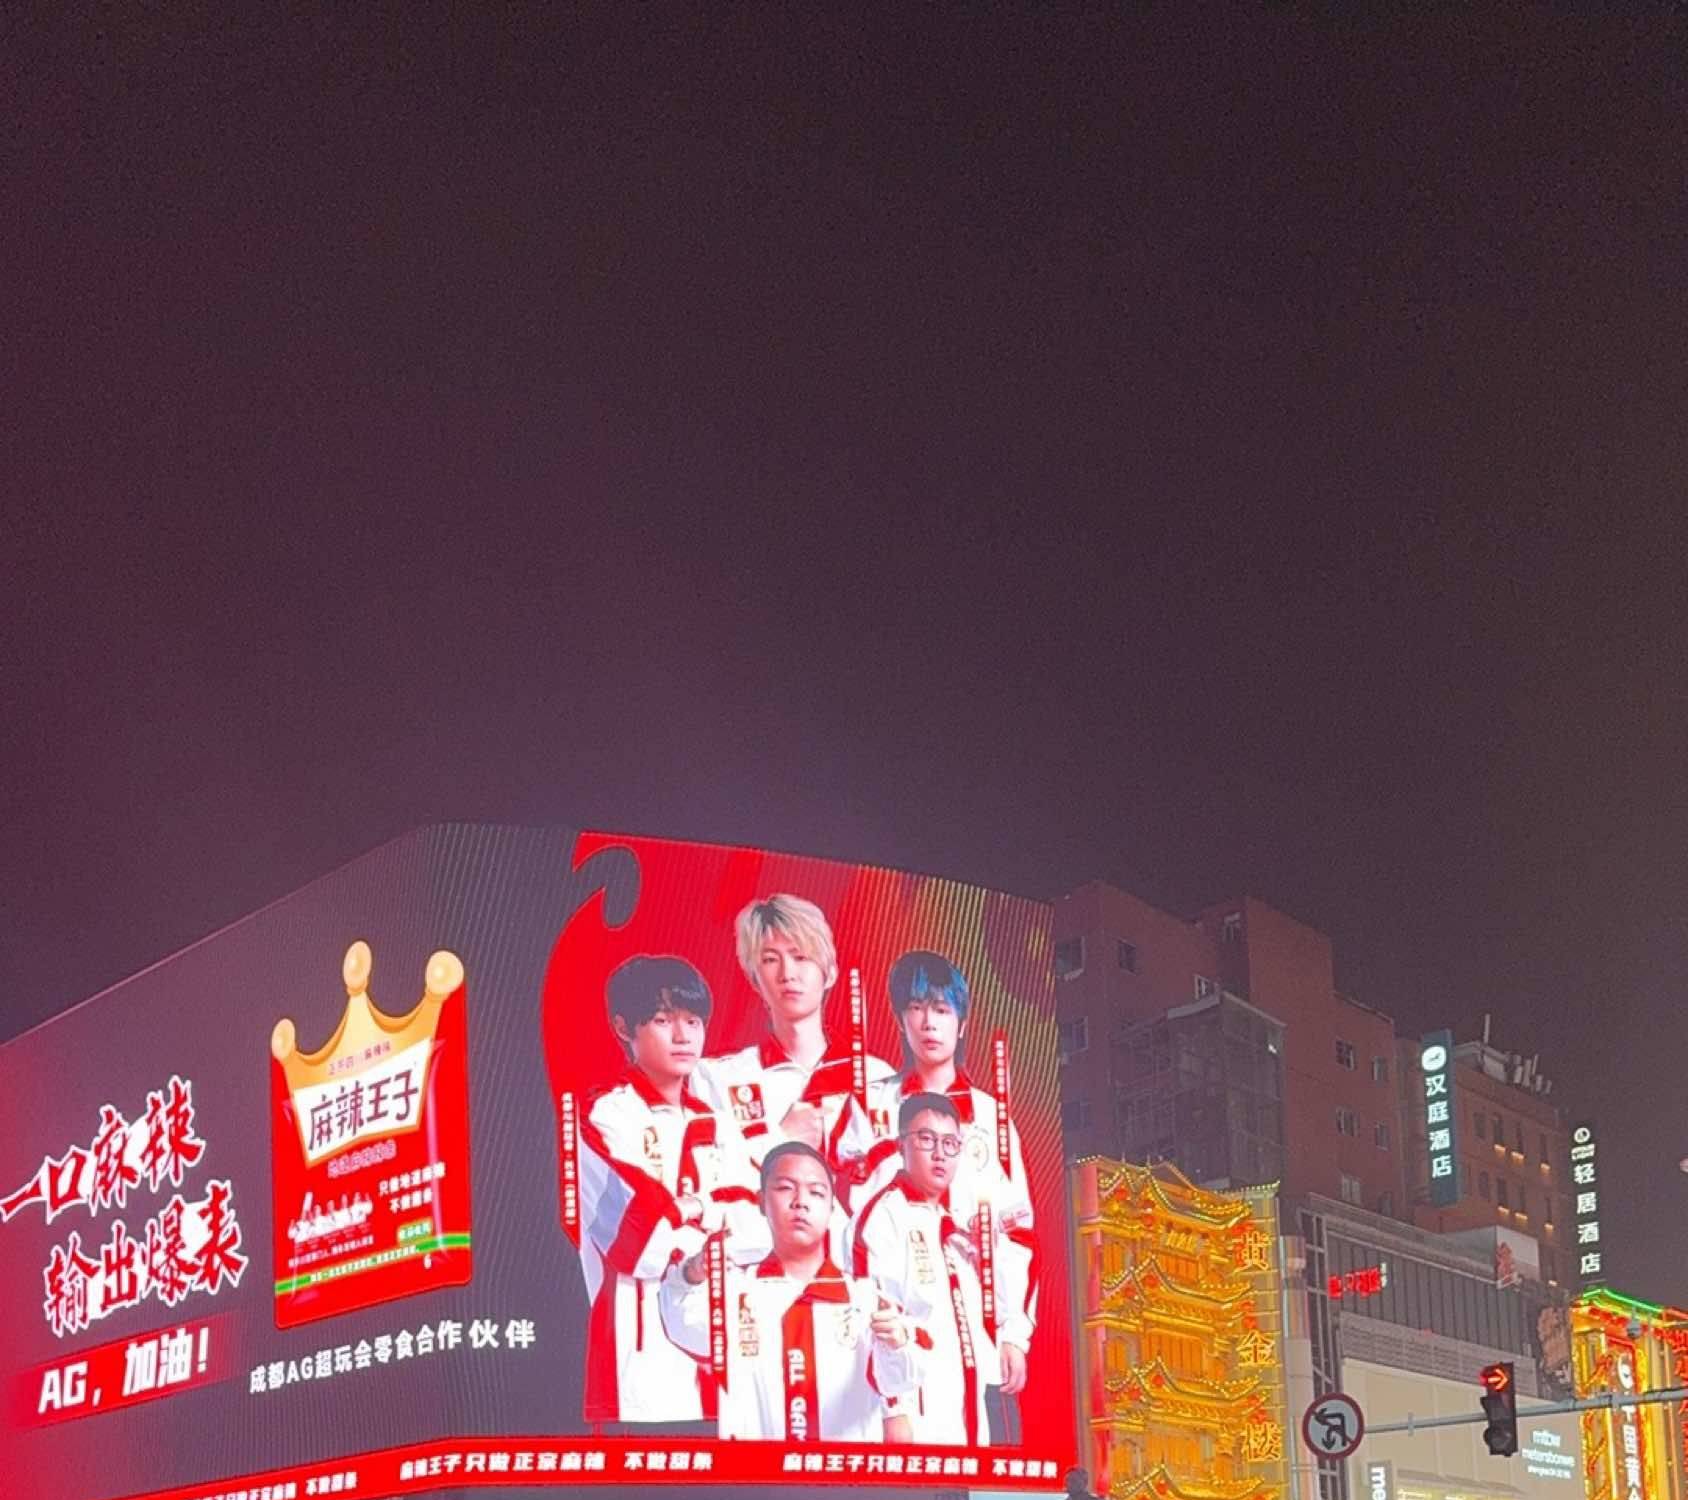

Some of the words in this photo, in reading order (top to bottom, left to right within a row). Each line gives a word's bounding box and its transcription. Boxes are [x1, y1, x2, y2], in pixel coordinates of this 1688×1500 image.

[0, 1076, 206, 1224] 一口麻辣
[308, 1068, 419, 1150] 麻辣王子
[1425, 1074, 1453, 1179] 汉庭酒店
[44, 1180, 248, 1338] 输出爆表
[1573, 1163, 1601, 1275] 轻居酒店
[249, 1319, 537, 1395] 成都AG超玩会零食合作伙伴
